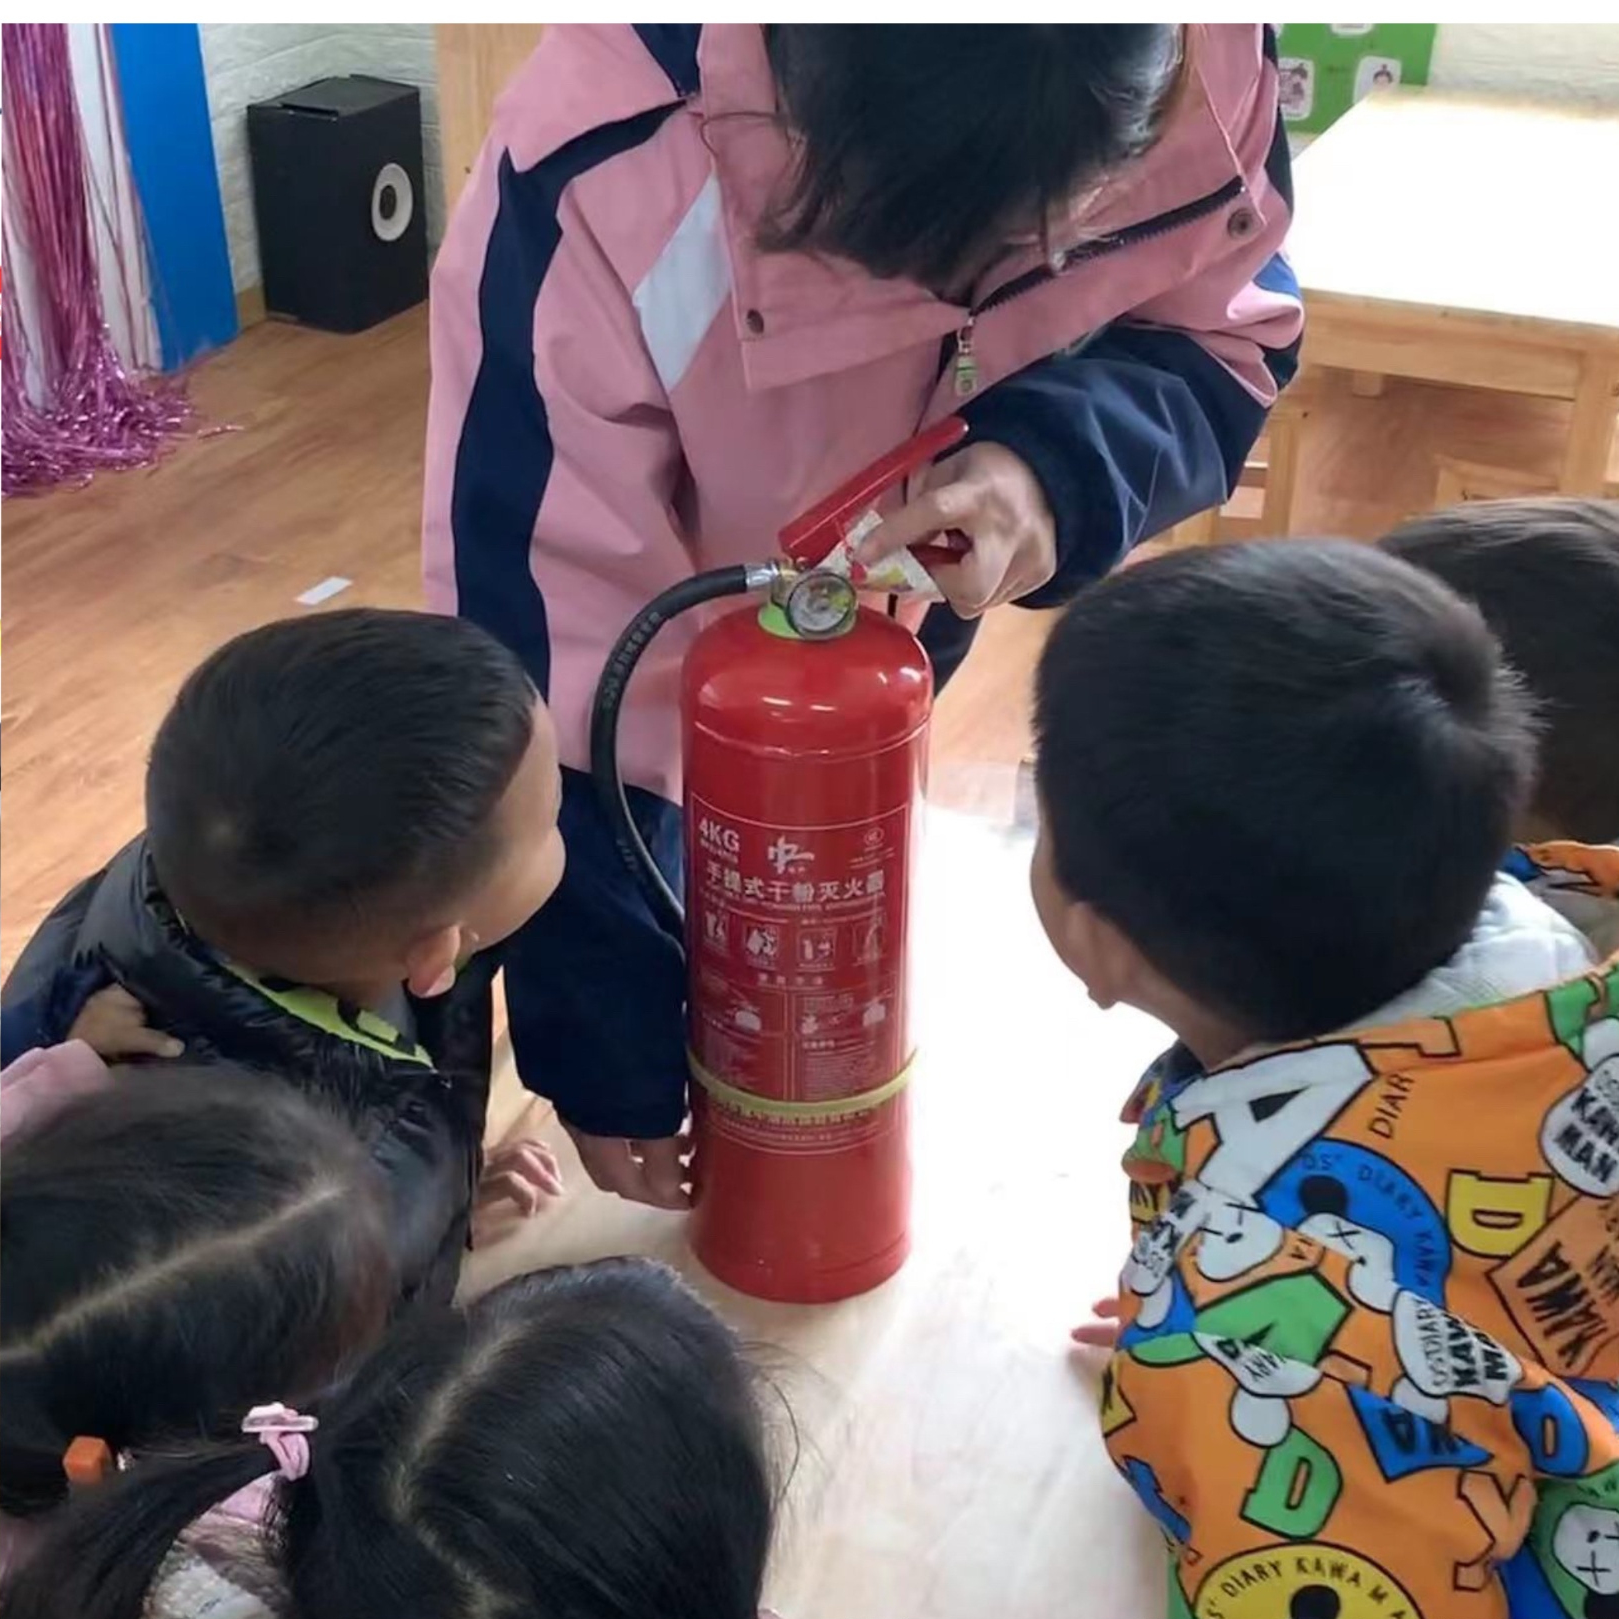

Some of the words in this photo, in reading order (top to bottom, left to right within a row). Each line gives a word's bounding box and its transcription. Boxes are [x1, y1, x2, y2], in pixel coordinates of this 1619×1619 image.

[699, 817, 740, 852] 4KG
[1219, 1558, 1283, 1599] DIARY
[1295, 1556, 1362, 1589] KAWA
